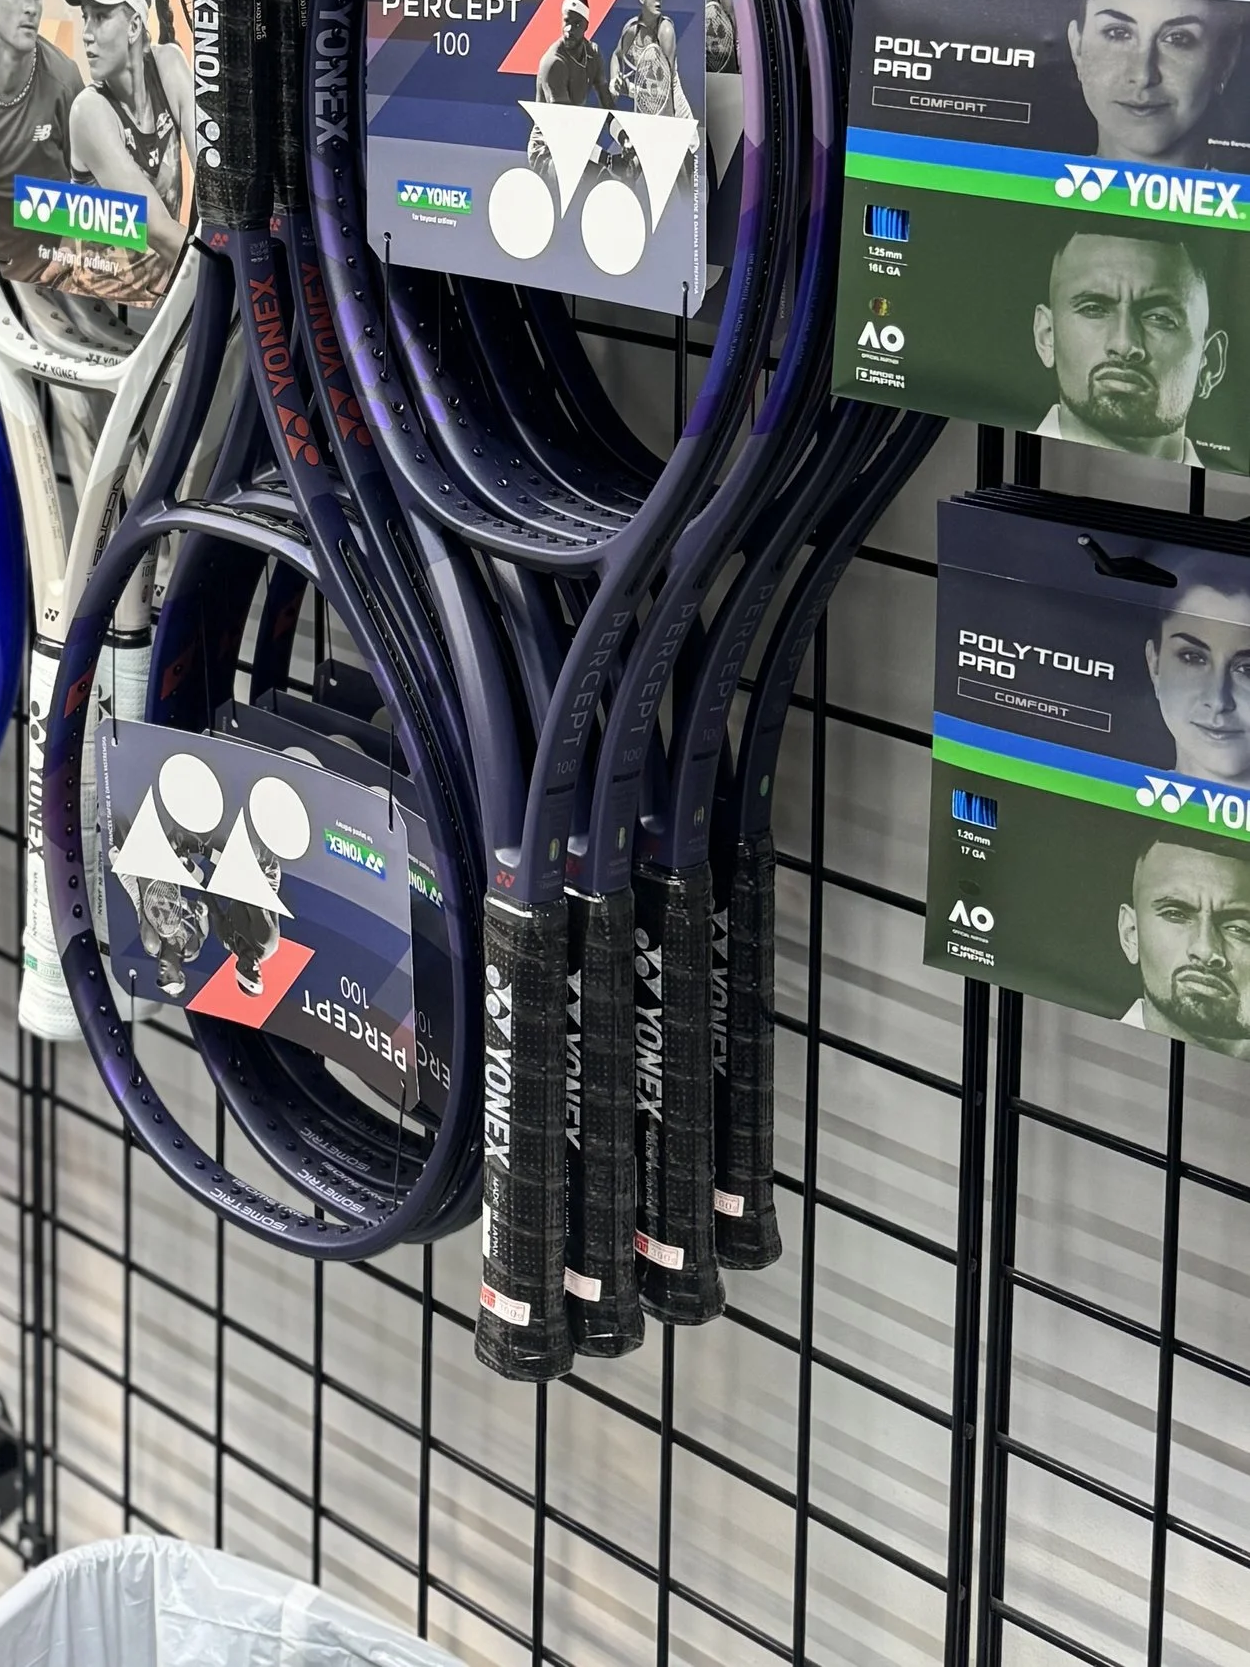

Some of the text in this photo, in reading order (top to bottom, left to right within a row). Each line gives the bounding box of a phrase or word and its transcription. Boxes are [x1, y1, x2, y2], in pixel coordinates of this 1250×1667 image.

[432, 31, 470, 56] 100
[874, 36, 1035, 69] POLYTOUR
[315, 9, 351, 146] YONEX
[873, 57, 932, 81] PRO
[908, 95, 987, 113] COMFORT
[426, 186, 469, 211] YONEX
[1124, 171, 1241, 220] YONEX
[65, 192, 142, 240] YONEX
[38, 244, 122, 276] far beyond ordinary
[868, 263, 901, 277] 16L GA
[248, 274, 295, 397] YONEX
[857, 321, 905, 352] AO
[50, 365, 83, 382] YONEX
[869, 376, 905, 389] JAPAN
[92, 474, 125, 567] VCORE
[709, 582, 775, 714] PERCEPT
[959, 628, 1116, 681] POLYTOUR
[563, 611, 629, 748] PERCEPT
[630, 602, 698, 735] PERCEPT
[958, 651, 1016, 680] PRO
[994, 690, 1070, 718] COMFORT
[557, 758, 576, 774] 100
[29, 766, 45, 861] YONEX
[329, 835, 364, 865] YONEX
[960, 846, 986, 860] 17 GA
[948, 899, 995, 932] AO
[959, 951, 995, 967] JAPAN
[341, 976, 370, 1010] 100
[302, 989, 408, 1073] PERCEPT
[635, 1006, 663, 1122] YONEX
[484, 1045, 512, 1169] YONEX
[301, 1126, 371, 1173] ISOMETRIC
[297, 1168, 366, 1214] ISOMETRIC
[209, 1187, 288, 1232] ISOMETRIC
[492, 1176, 500, 1257] MADE IN JAPAN
